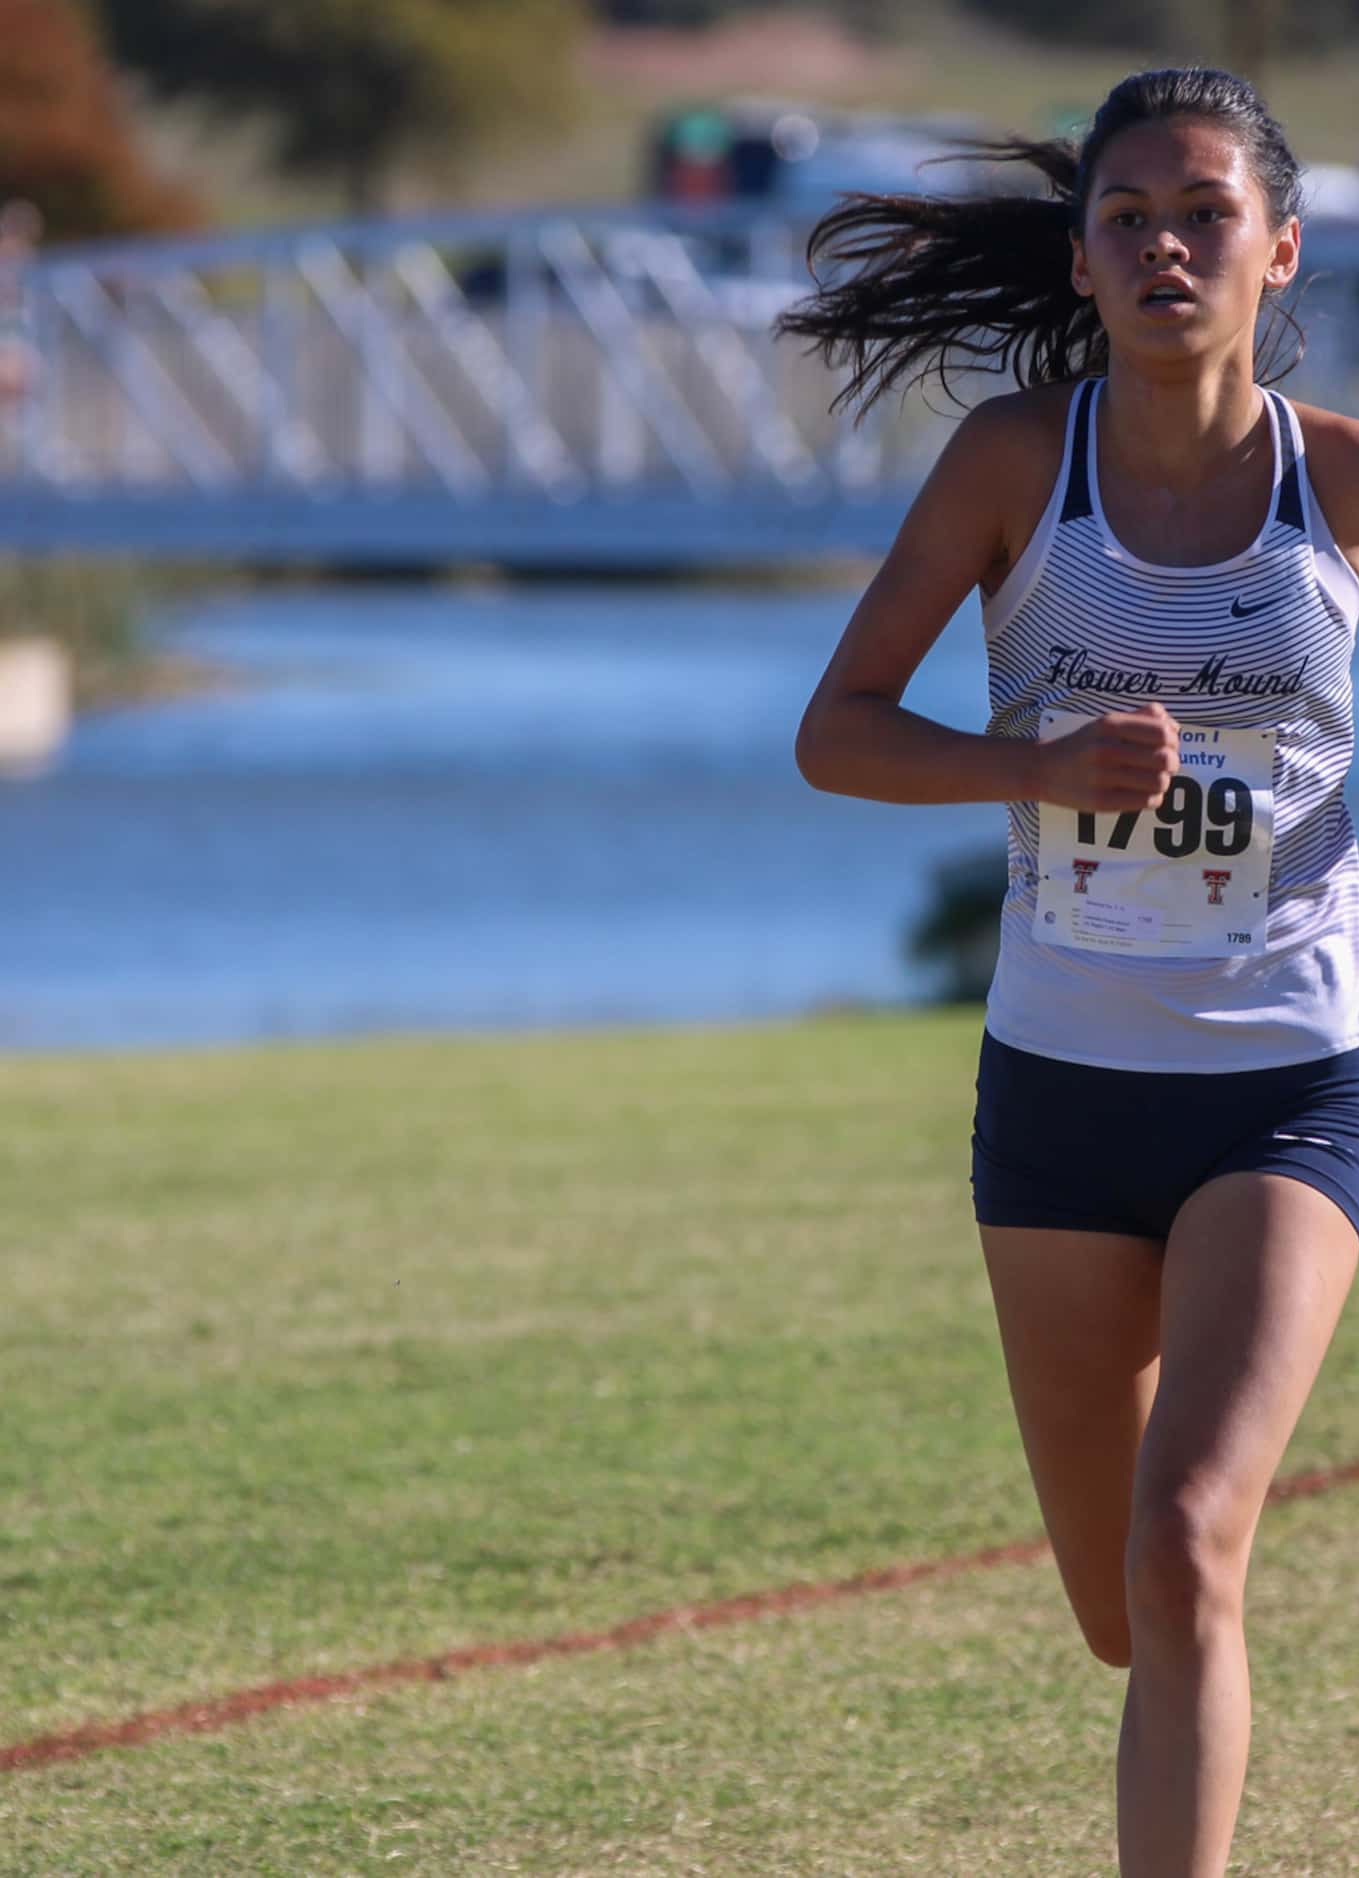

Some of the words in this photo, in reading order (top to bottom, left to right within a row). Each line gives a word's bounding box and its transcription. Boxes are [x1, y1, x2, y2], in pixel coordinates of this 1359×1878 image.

[1047, 645, 1162, 694] Flower
[1179, 653, 1309, 696] Mound
[1178, 751, 1226, 768] untry
